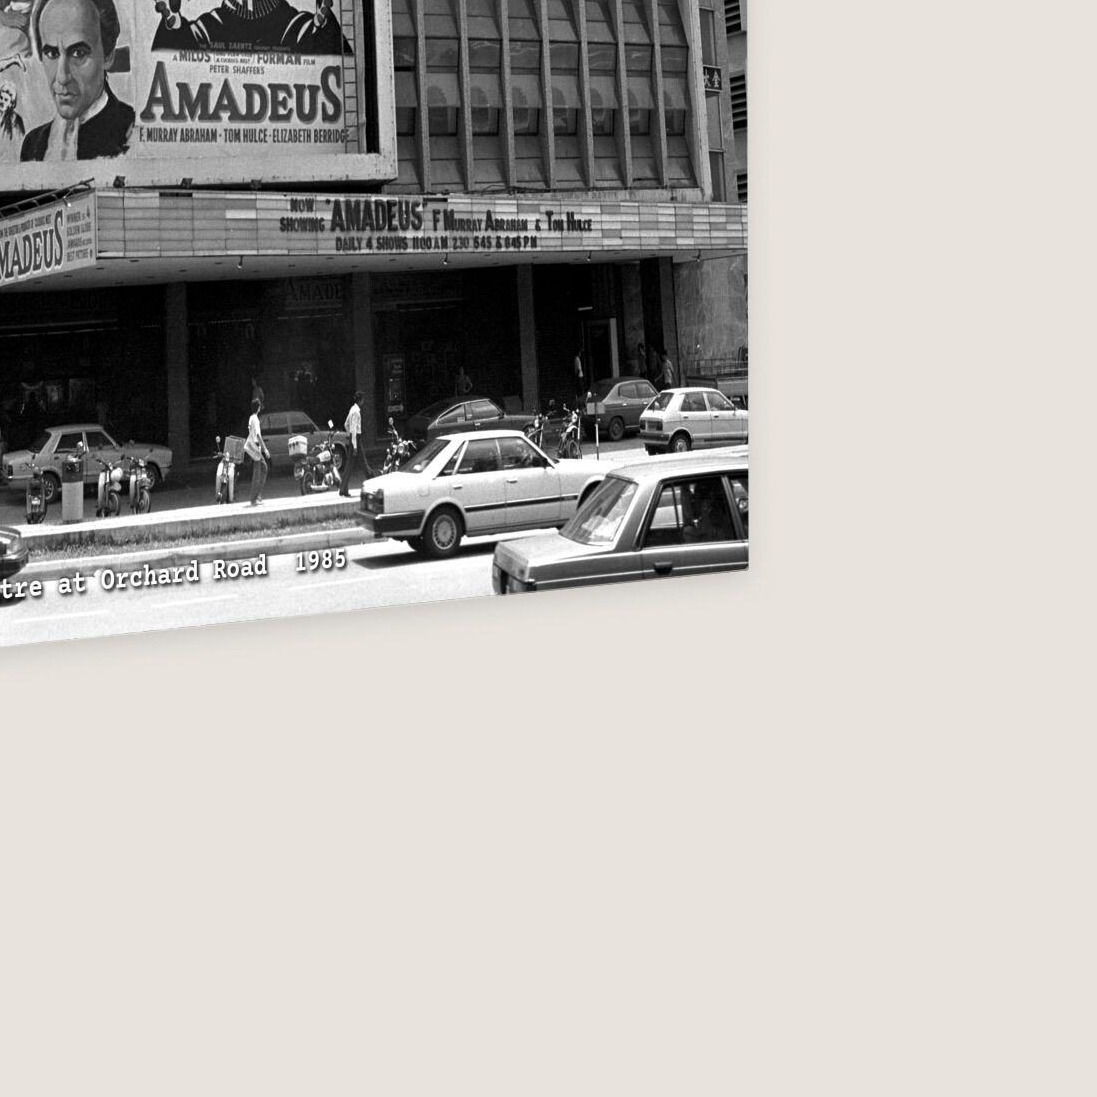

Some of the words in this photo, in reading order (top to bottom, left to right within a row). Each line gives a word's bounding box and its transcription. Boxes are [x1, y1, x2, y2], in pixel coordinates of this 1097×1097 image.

[209, 41, 226, 49] SAUL
[179, 50, 211, 63] MILOS
[257, 52, 302, 65] FORMAN
[209, 64, 229, 74] PETER
[140, 60, 343, 125] AMADEUS
[139, 129, 146, 142] F.
[147, 129, 178, 143] MURRAY
[180, 128, 217, 143] ABRAHAM
[224, 129, 241, 143] TOM
[243, 129, 268, 143] HULCE
[273, 129, 312, 143] ELIZABETH
[314, 129, 350, 143] BERRIDGE
[290, 198, 314, 212] NOW
[280, 217, 325, 232] SHOWING
[433, 209, 440, 231] F
[535, 218, 541, 231] &
[335, 236, 363, 251] DAILY
[366, 236, 373, 250] 4
[376, 236, 408, 251] SHOWS
